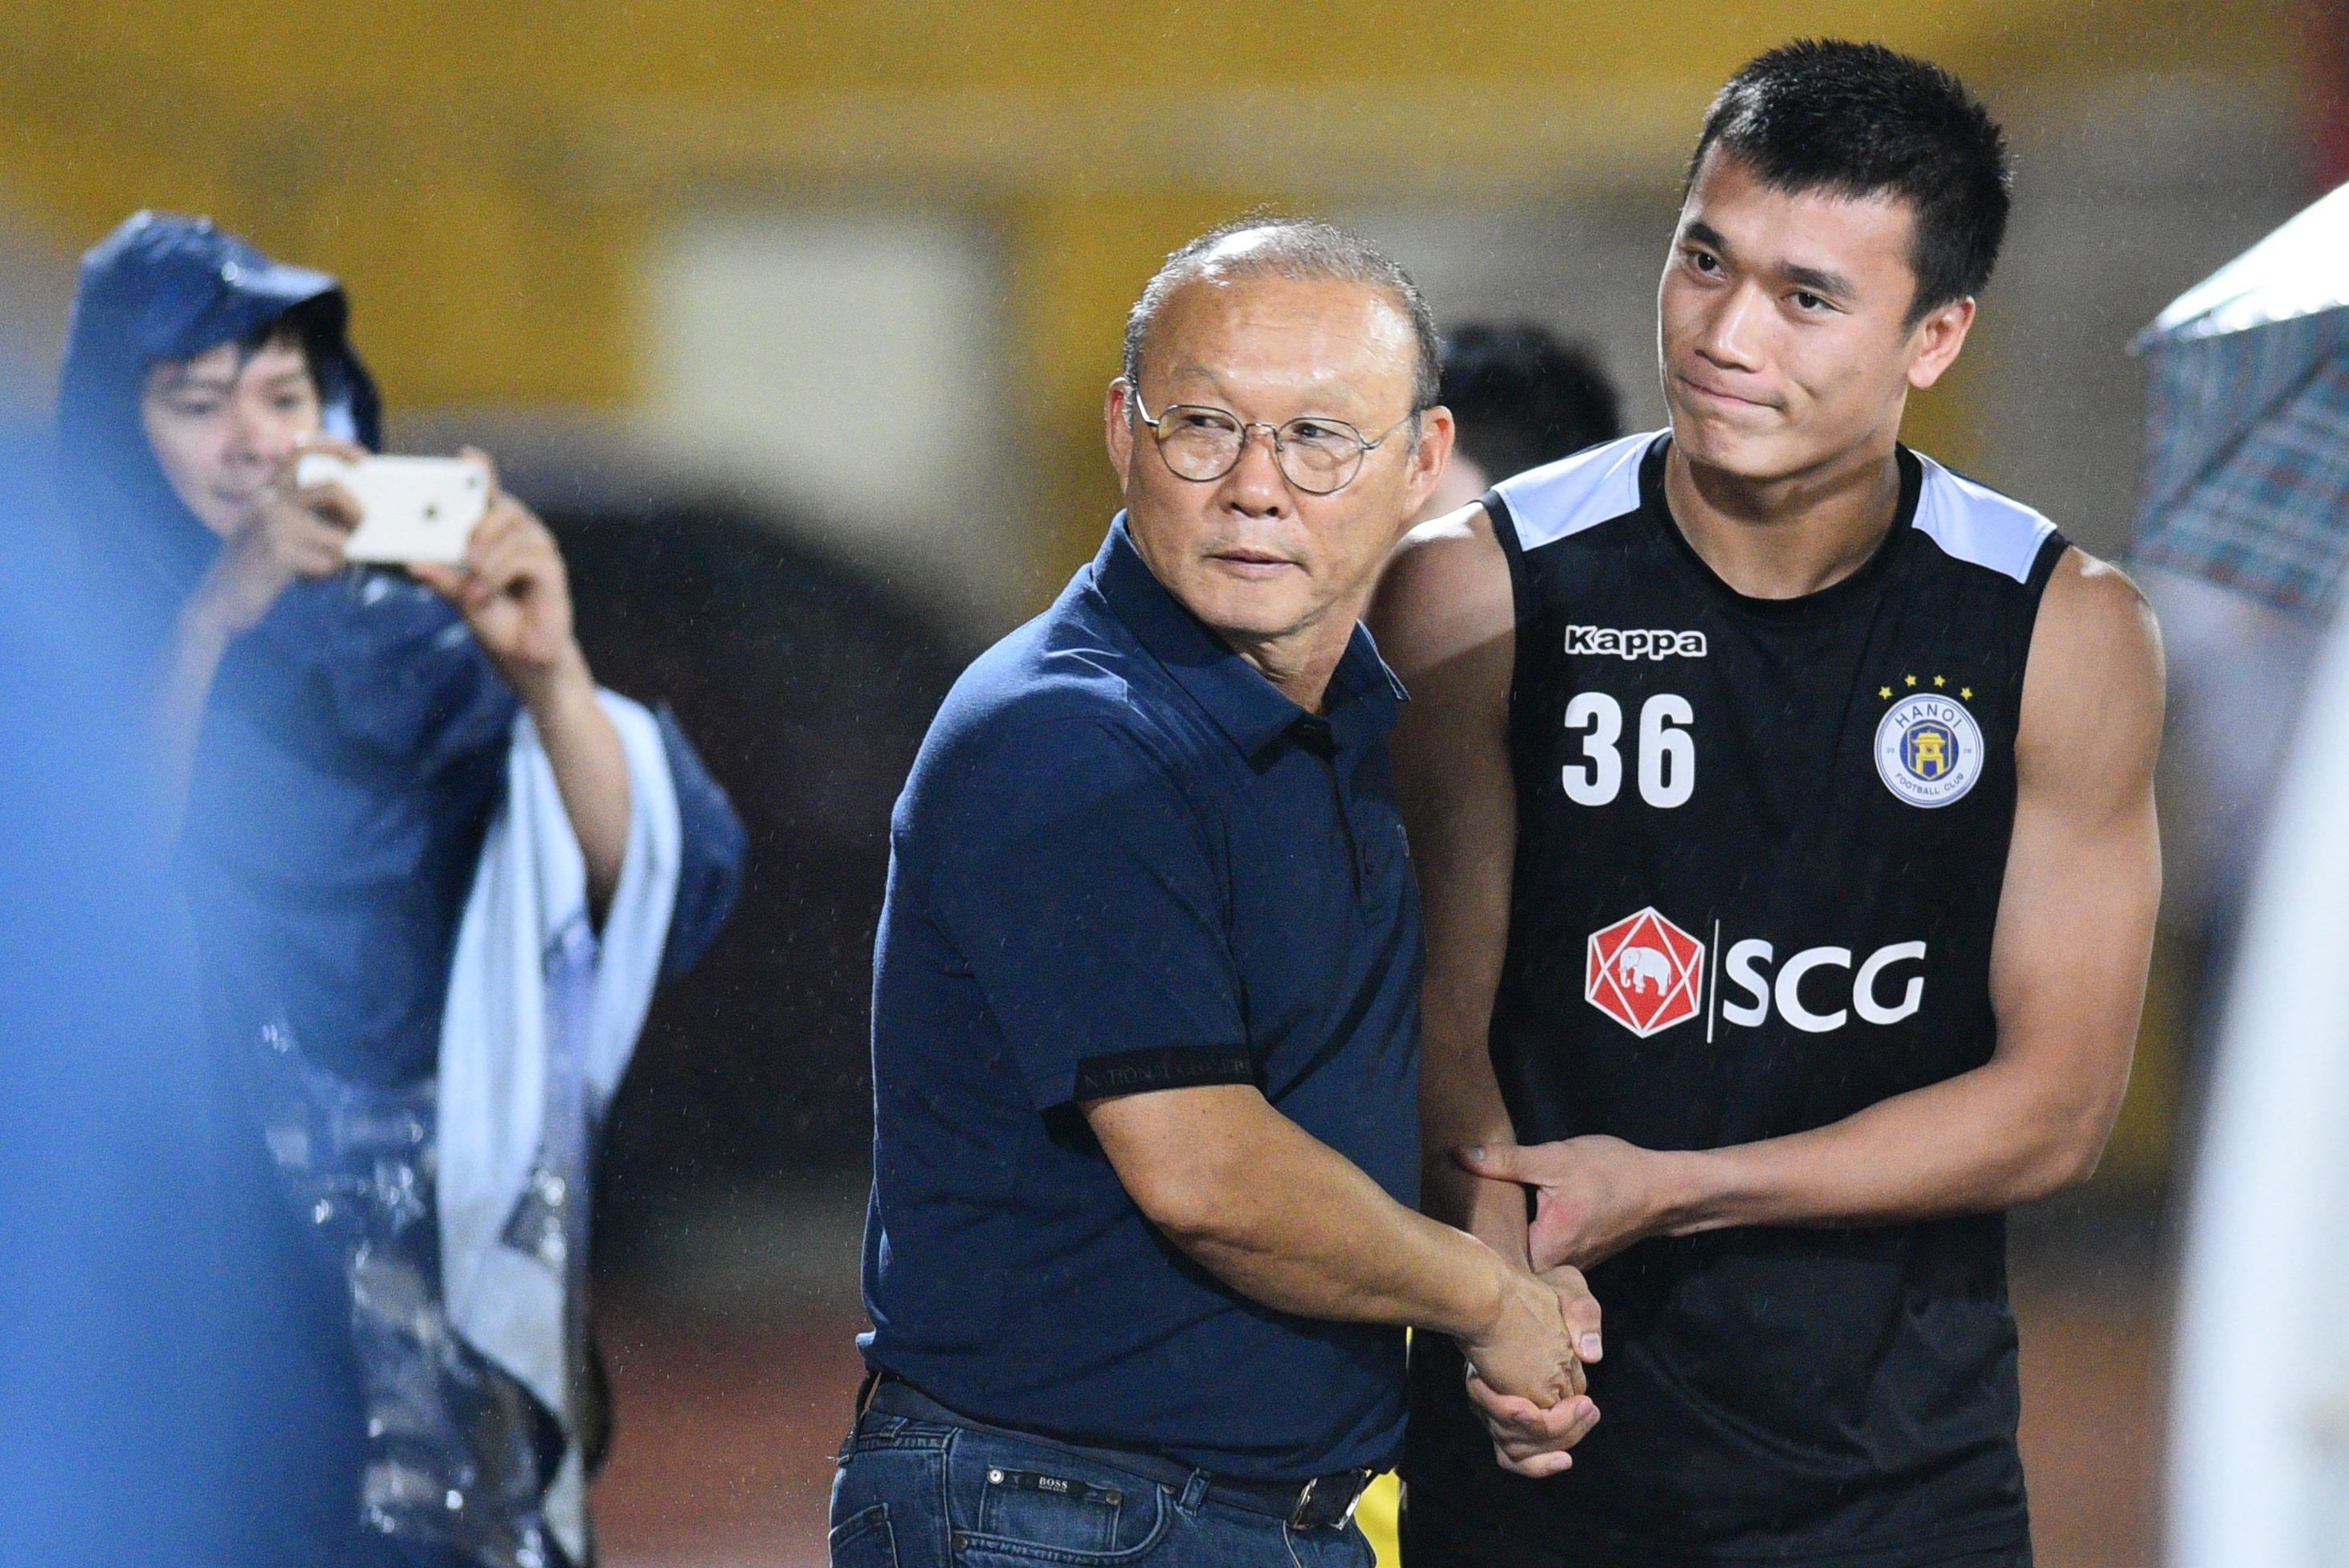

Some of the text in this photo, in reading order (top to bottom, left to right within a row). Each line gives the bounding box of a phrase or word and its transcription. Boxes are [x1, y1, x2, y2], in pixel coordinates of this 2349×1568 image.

[1565, 625, 1707, 660] Kappa
[1894, 703, 1962, 729] HANOI
[1562, 691, 1695, 808] 36
[1895, 772, 1964, 796] FOOTBALL CLUB
[1723, 938, 1927, 1033] SCG
[1039, 1476, 1067, 1489] BOSS
